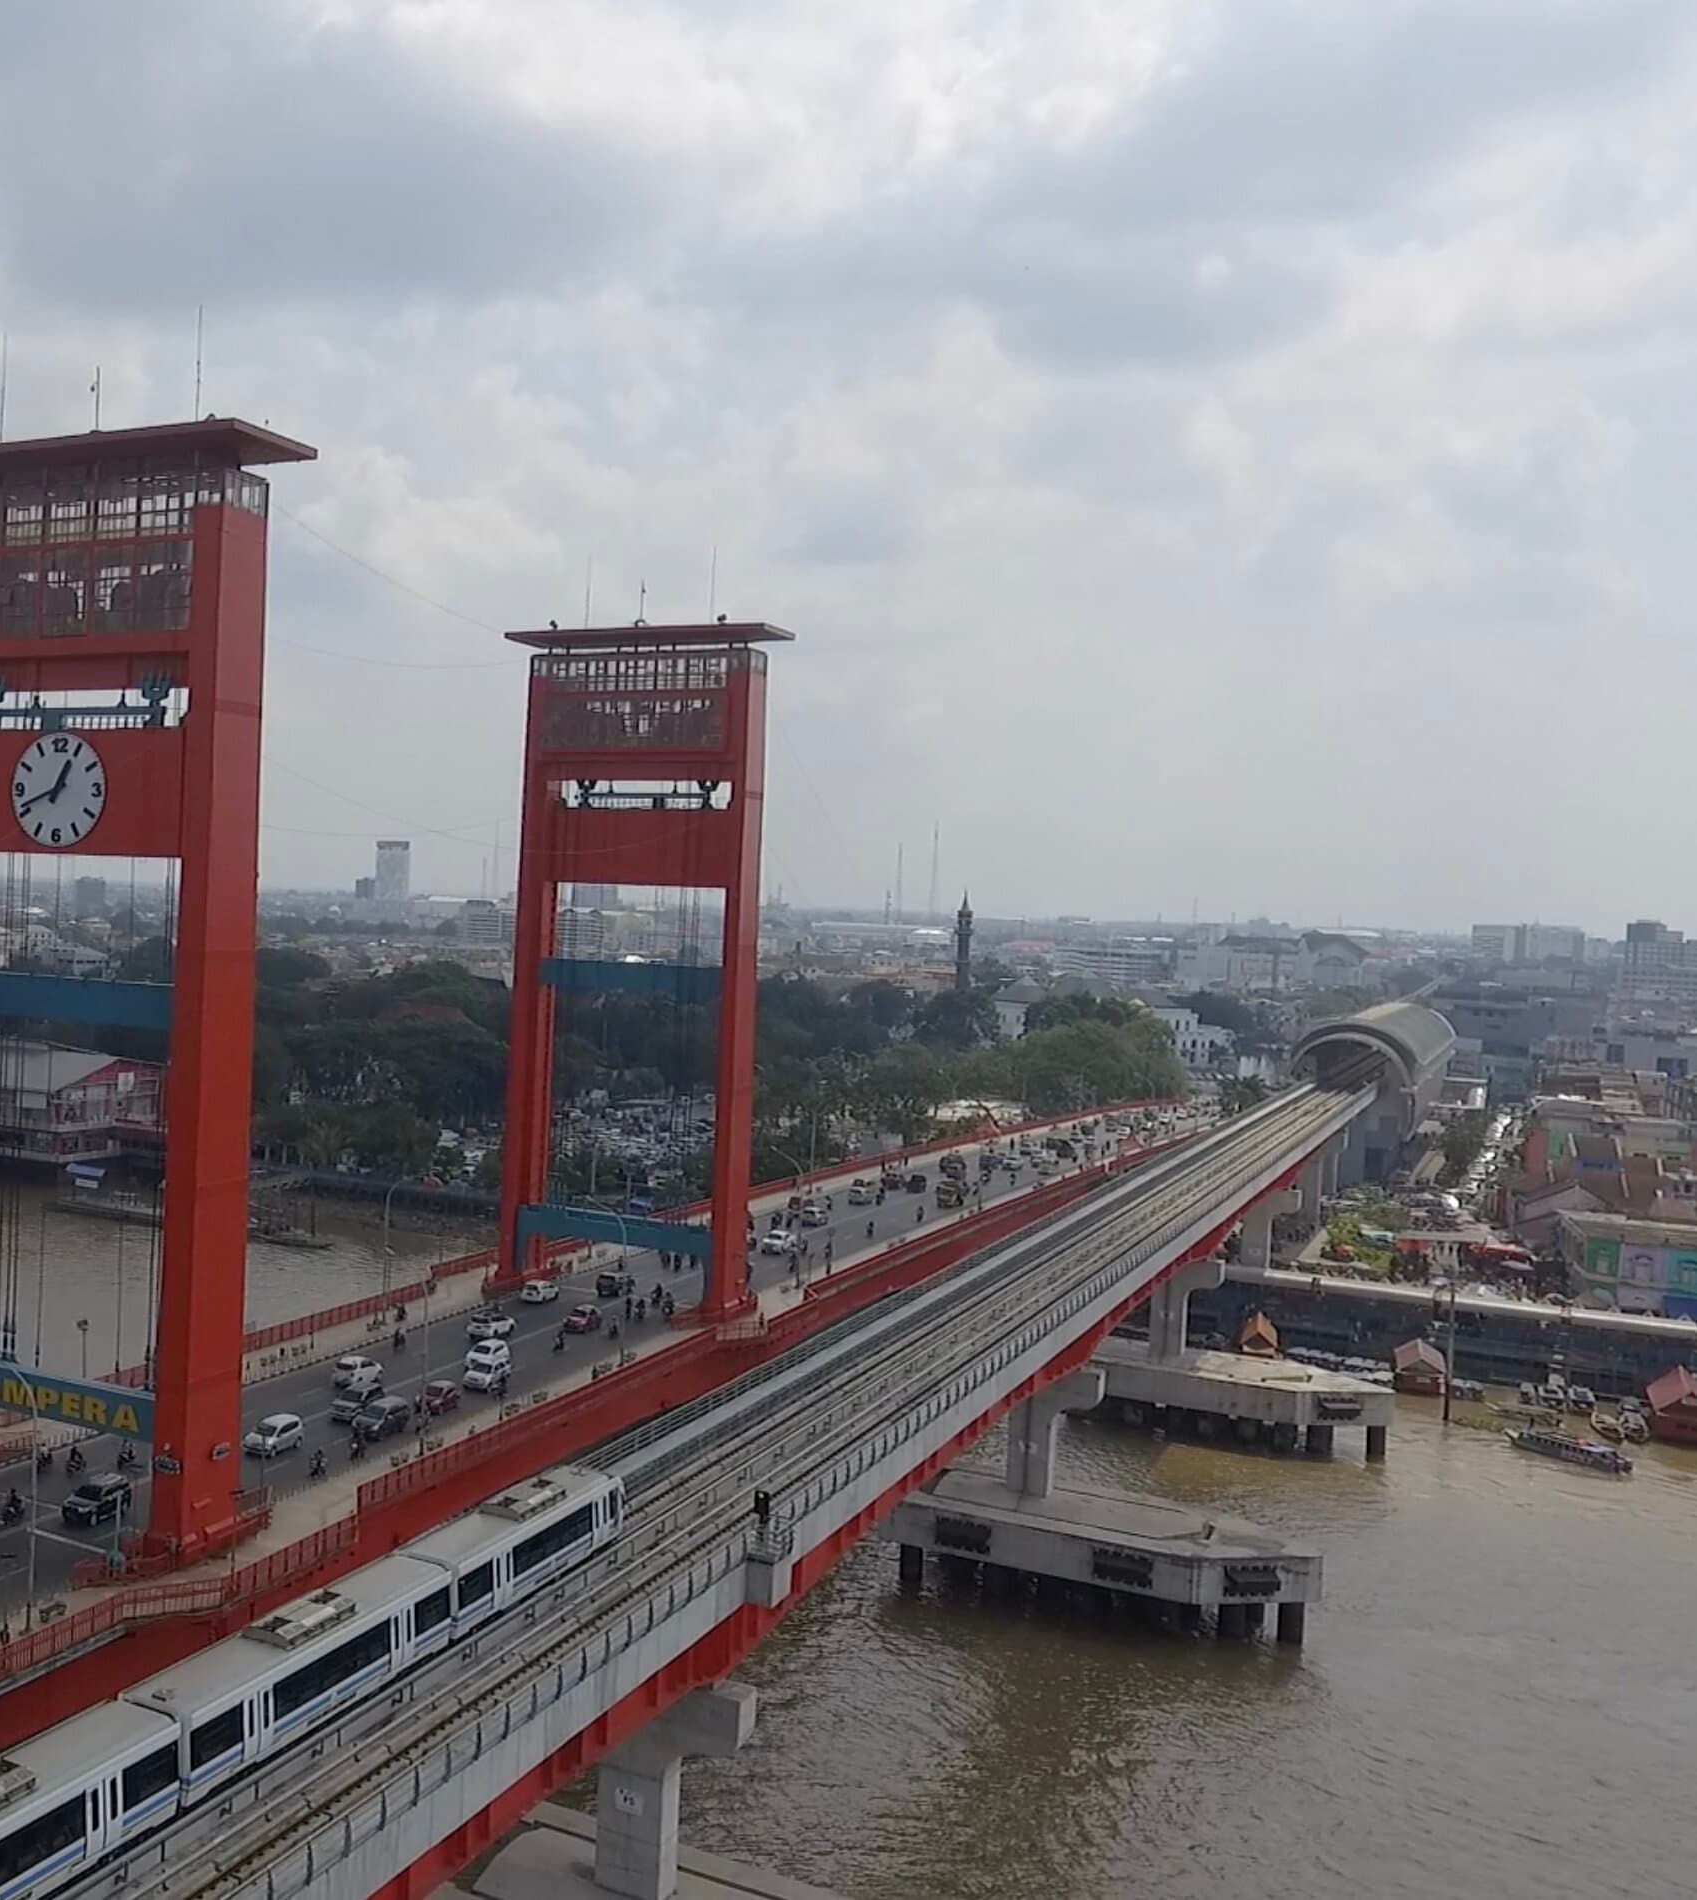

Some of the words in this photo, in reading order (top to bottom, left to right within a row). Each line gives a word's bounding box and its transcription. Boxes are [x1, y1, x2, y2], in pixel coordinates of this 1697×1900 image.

[51, 738, 69, 753] 12
[14, 782, 25, 798] 9
[91, 782, 102, 798] 3
[50, 828, 62, 842] 6
